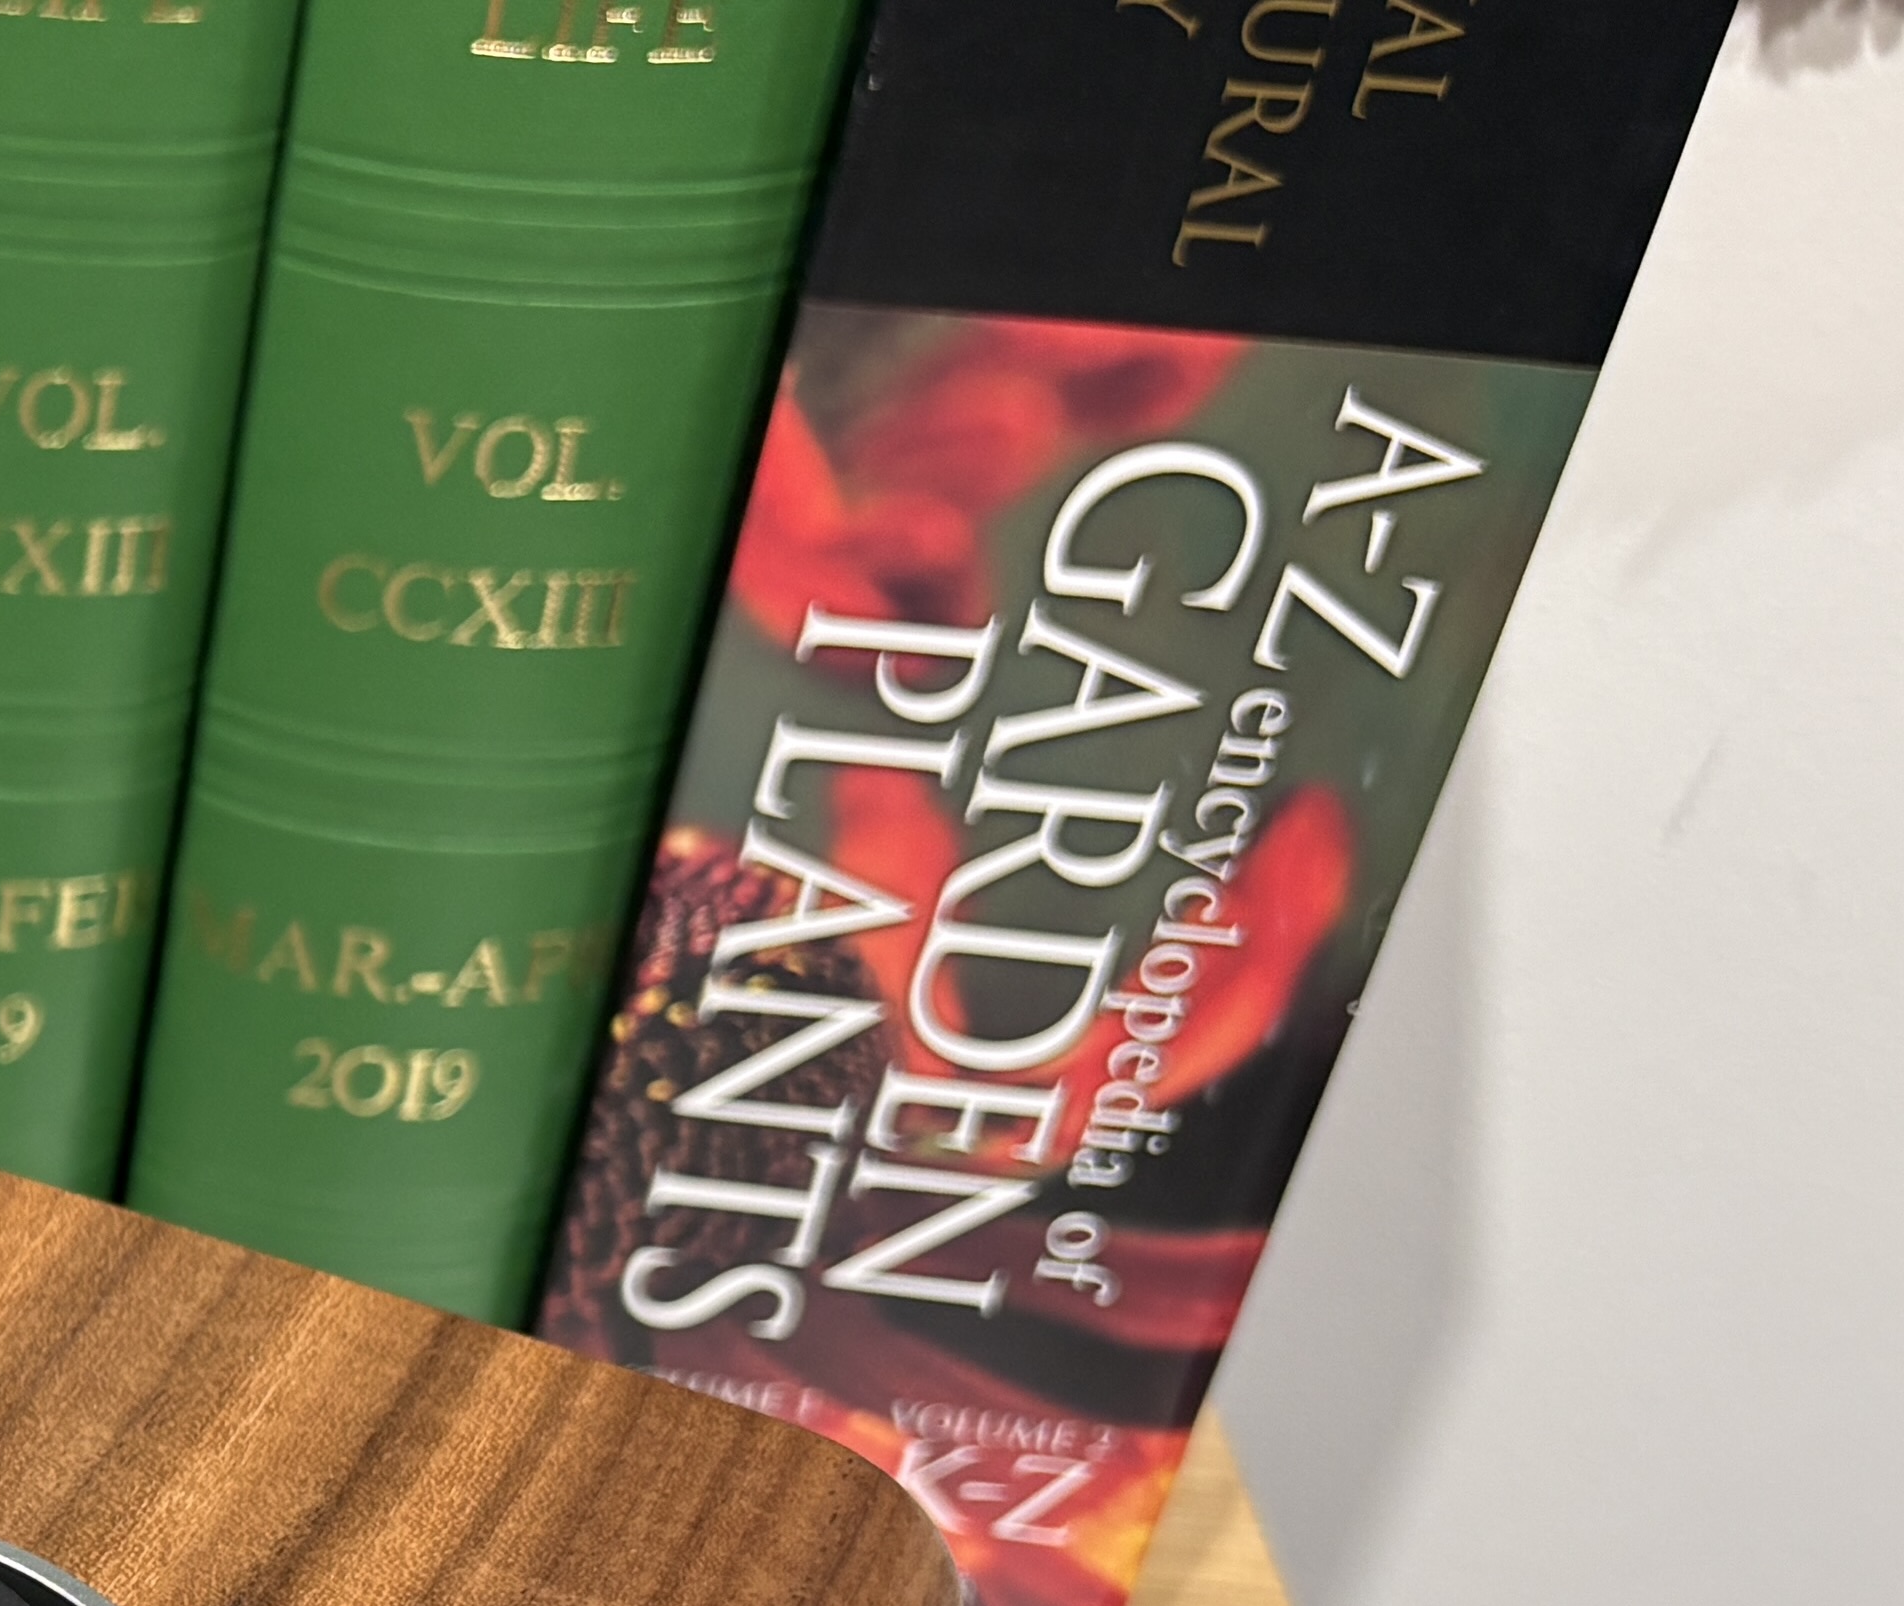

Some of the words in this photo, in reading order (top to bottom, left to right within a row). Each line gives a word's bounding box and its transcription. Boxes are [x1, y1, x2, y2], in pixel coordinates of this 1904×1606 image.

[402, 406, 627, 501] VOL.
[1254, 384, 1490, 680] A-Z
[316, 553, 639, 650] CCXIII
[822, 440, 1265, 1317] GARDEN
[620, 600, 1000, 1342] PLANTS
[1068, 687, 1292, 1190] encyclopedia
[286, 1036, 480, 1124] 2019
[1034, 1211, 1123, 1309] of
[890, 1397, 1080, 1453] VOLUME
[896, 1439, 1094, 1548] K-Z
